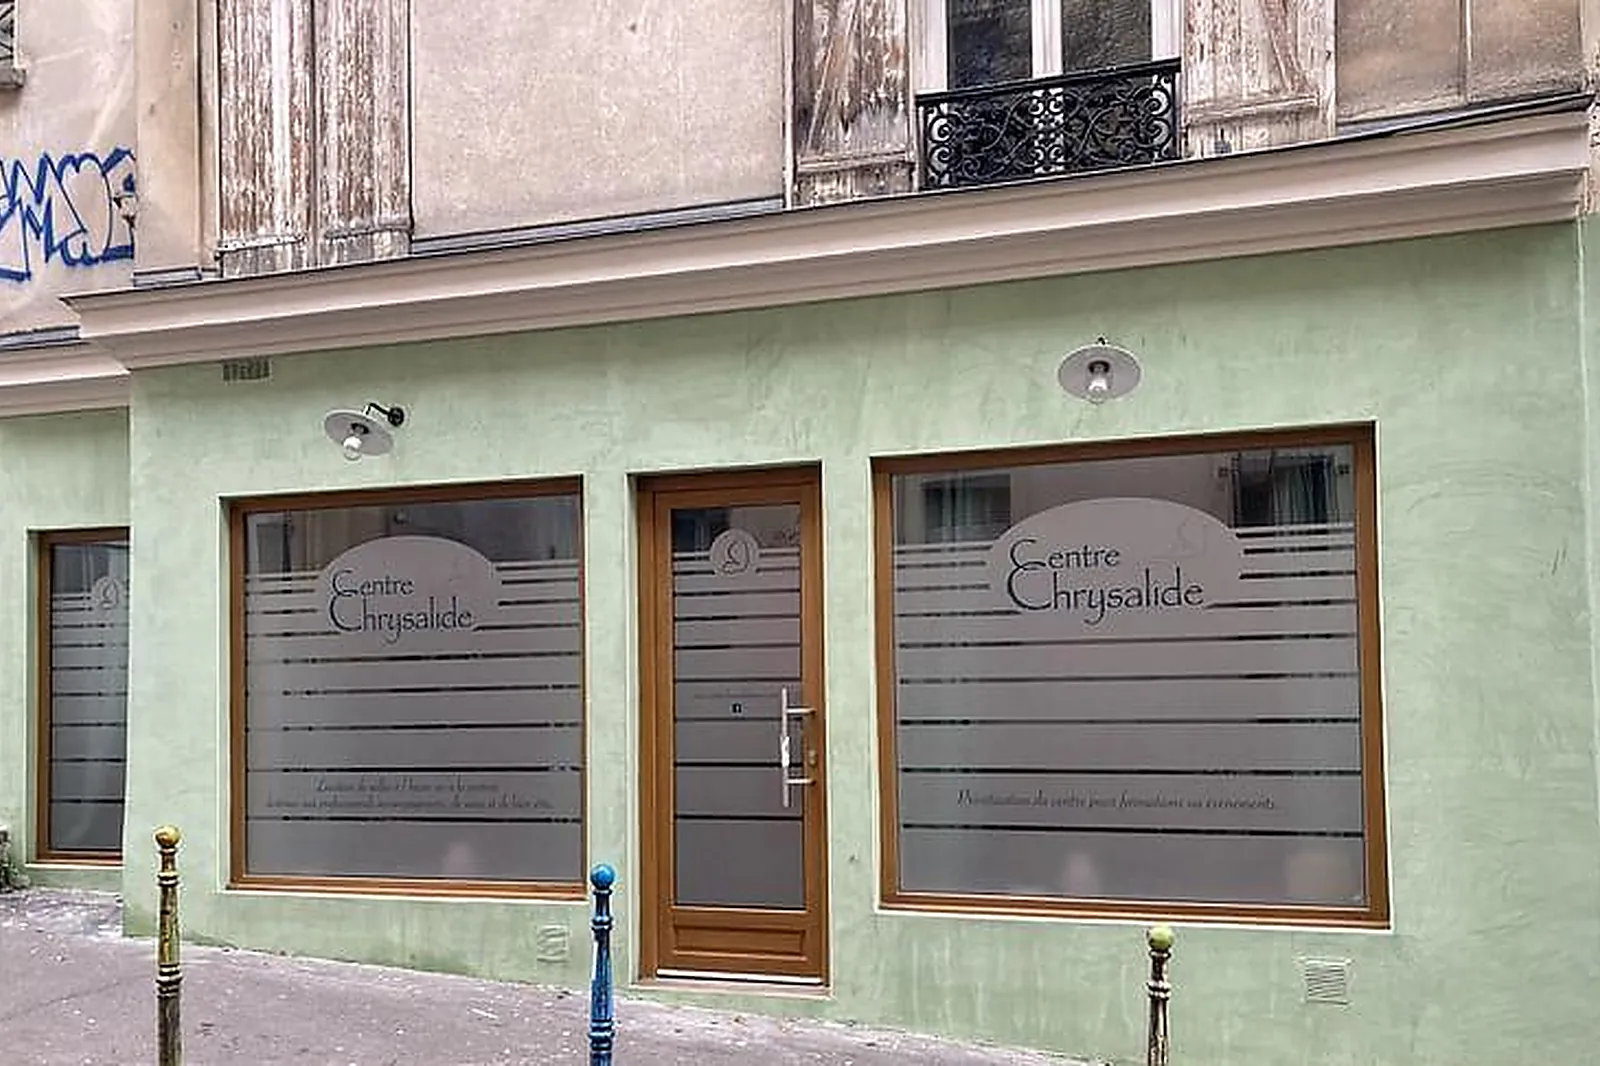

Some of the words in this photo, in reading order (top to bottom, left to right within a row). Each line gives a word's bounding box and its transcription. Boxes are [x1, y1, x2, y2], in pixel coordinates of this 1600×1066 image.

[1010, 538, 1121, 571] Centre
[332, 569, 414, 597] Centre
[1007, 564, 1204, 625] Chrysalide
[329, 593, 473, 644] Chrysalide
